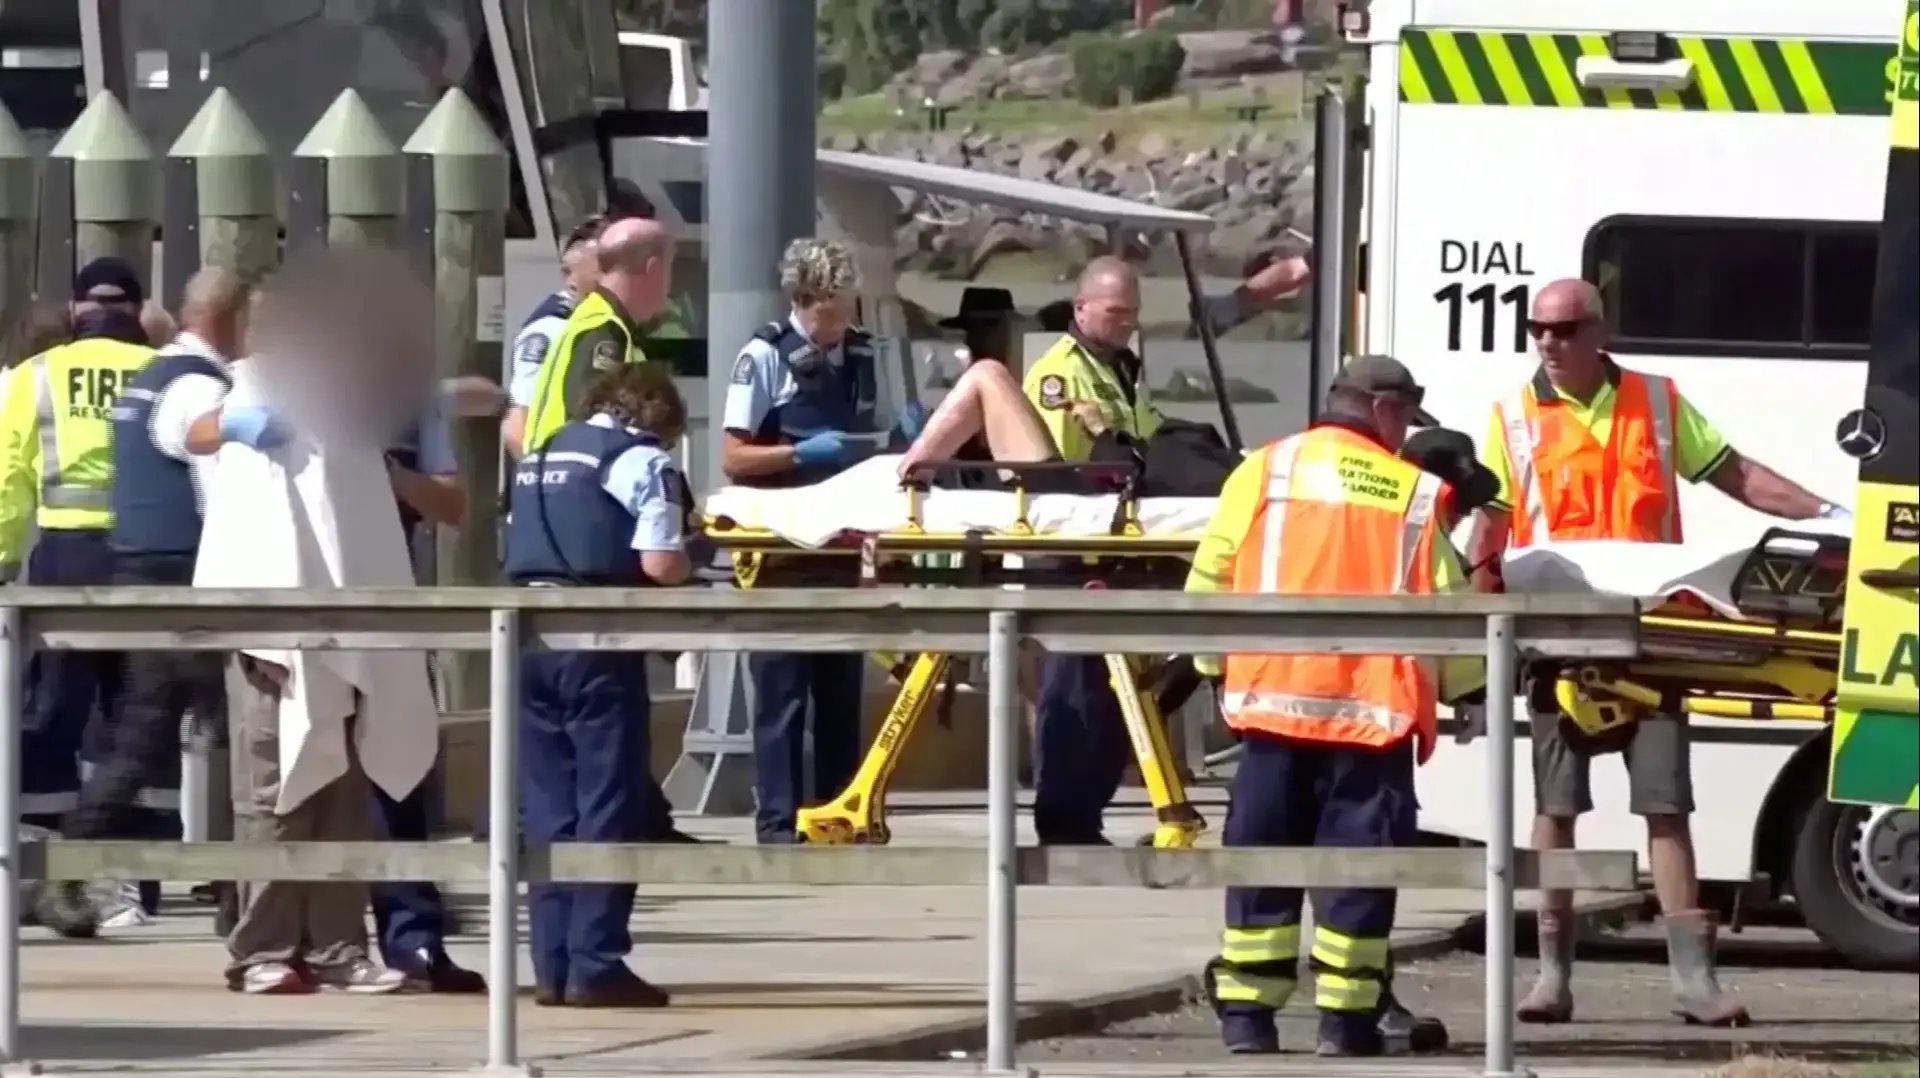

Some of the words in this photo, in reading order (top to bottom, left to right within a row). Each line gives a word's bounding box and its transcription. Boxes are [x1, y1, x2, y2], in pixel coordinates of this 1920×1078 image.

[1441, 239, 1535, 275] DIAL
[1433, 282, 1528, 353] 111
[1340, 456, 1374, 470] FIRE
[516, 470, 569, 486] POICE
